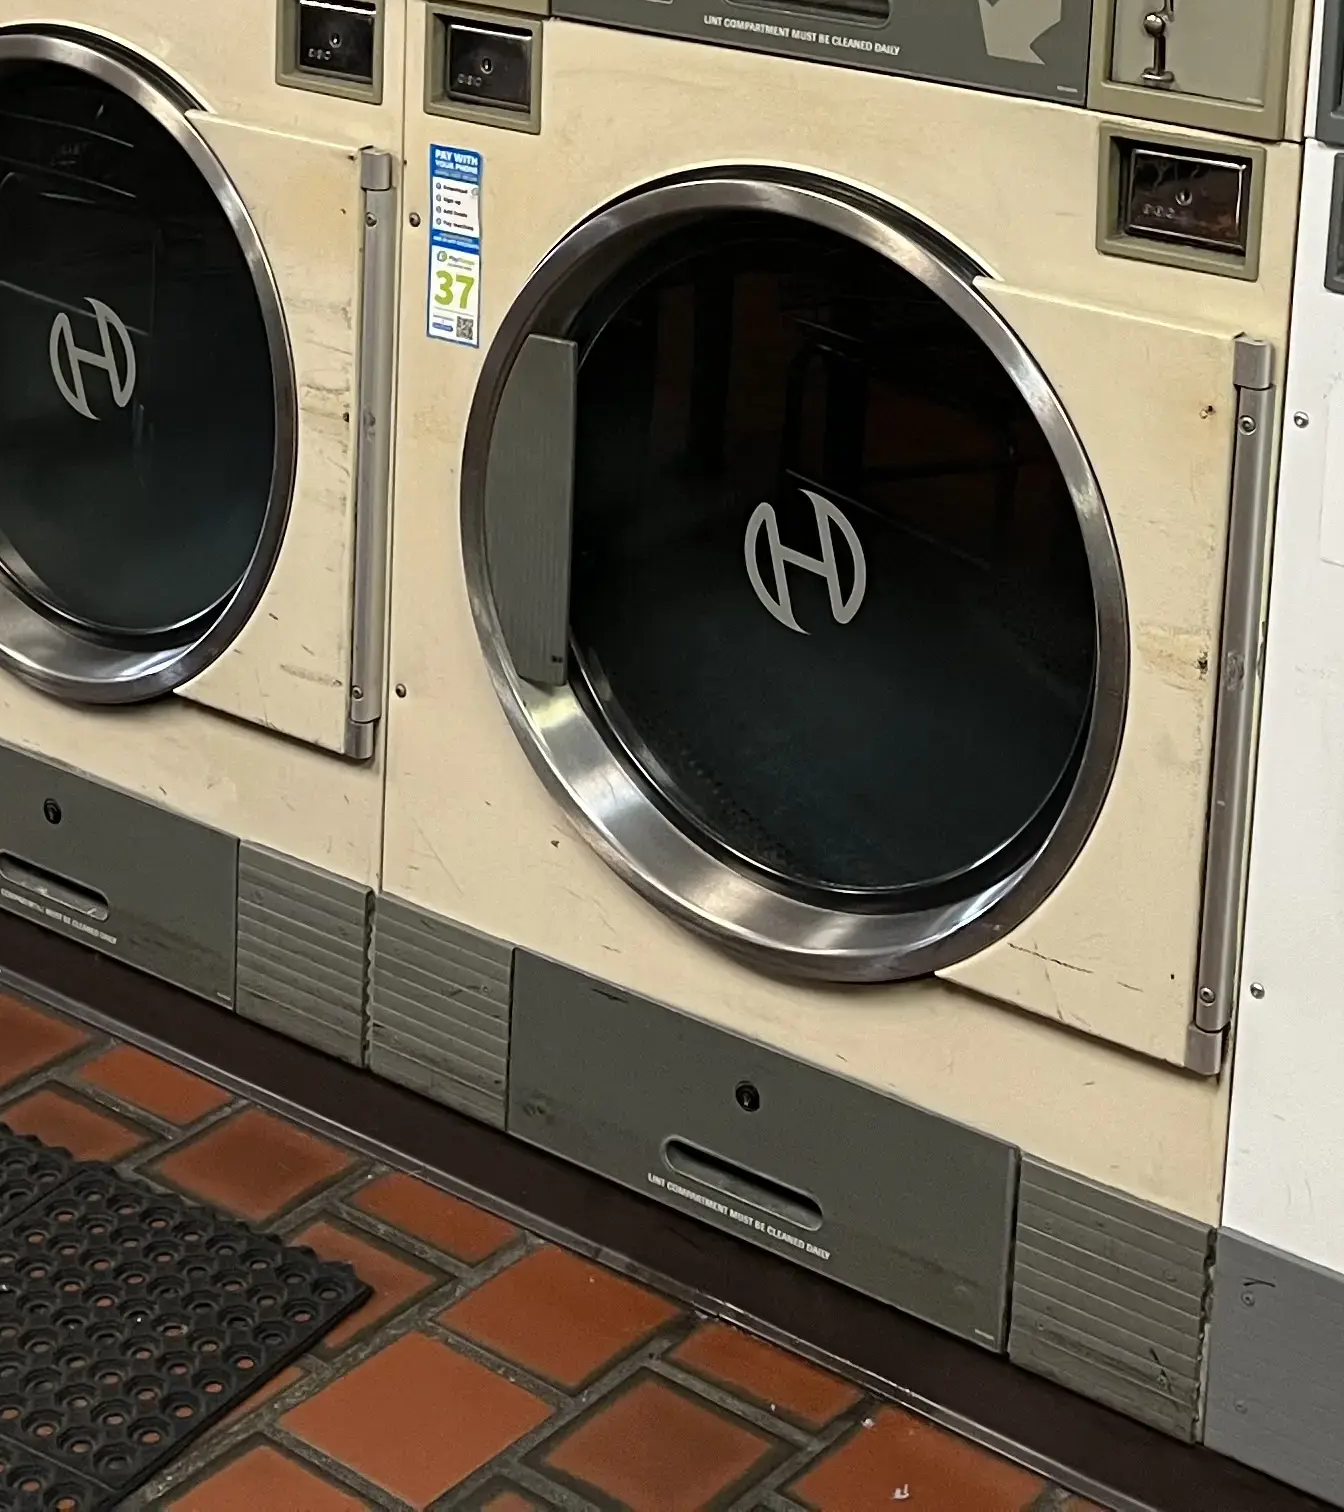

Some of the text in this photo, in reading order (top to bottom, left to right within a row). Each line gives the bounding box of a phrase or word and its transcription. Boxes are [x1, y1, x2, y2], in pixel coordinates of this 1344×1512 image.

[704, 14, 900, 56] LINT COMPARTMENT MUST BE CLEANED DAILY
[435, 149, 478, 166] PAY WITH
[434, 270, 475, 309] 37
[648, 1173, 831, 1261] LINT COMPARTMENT MUST BE CLEANED DAILY
